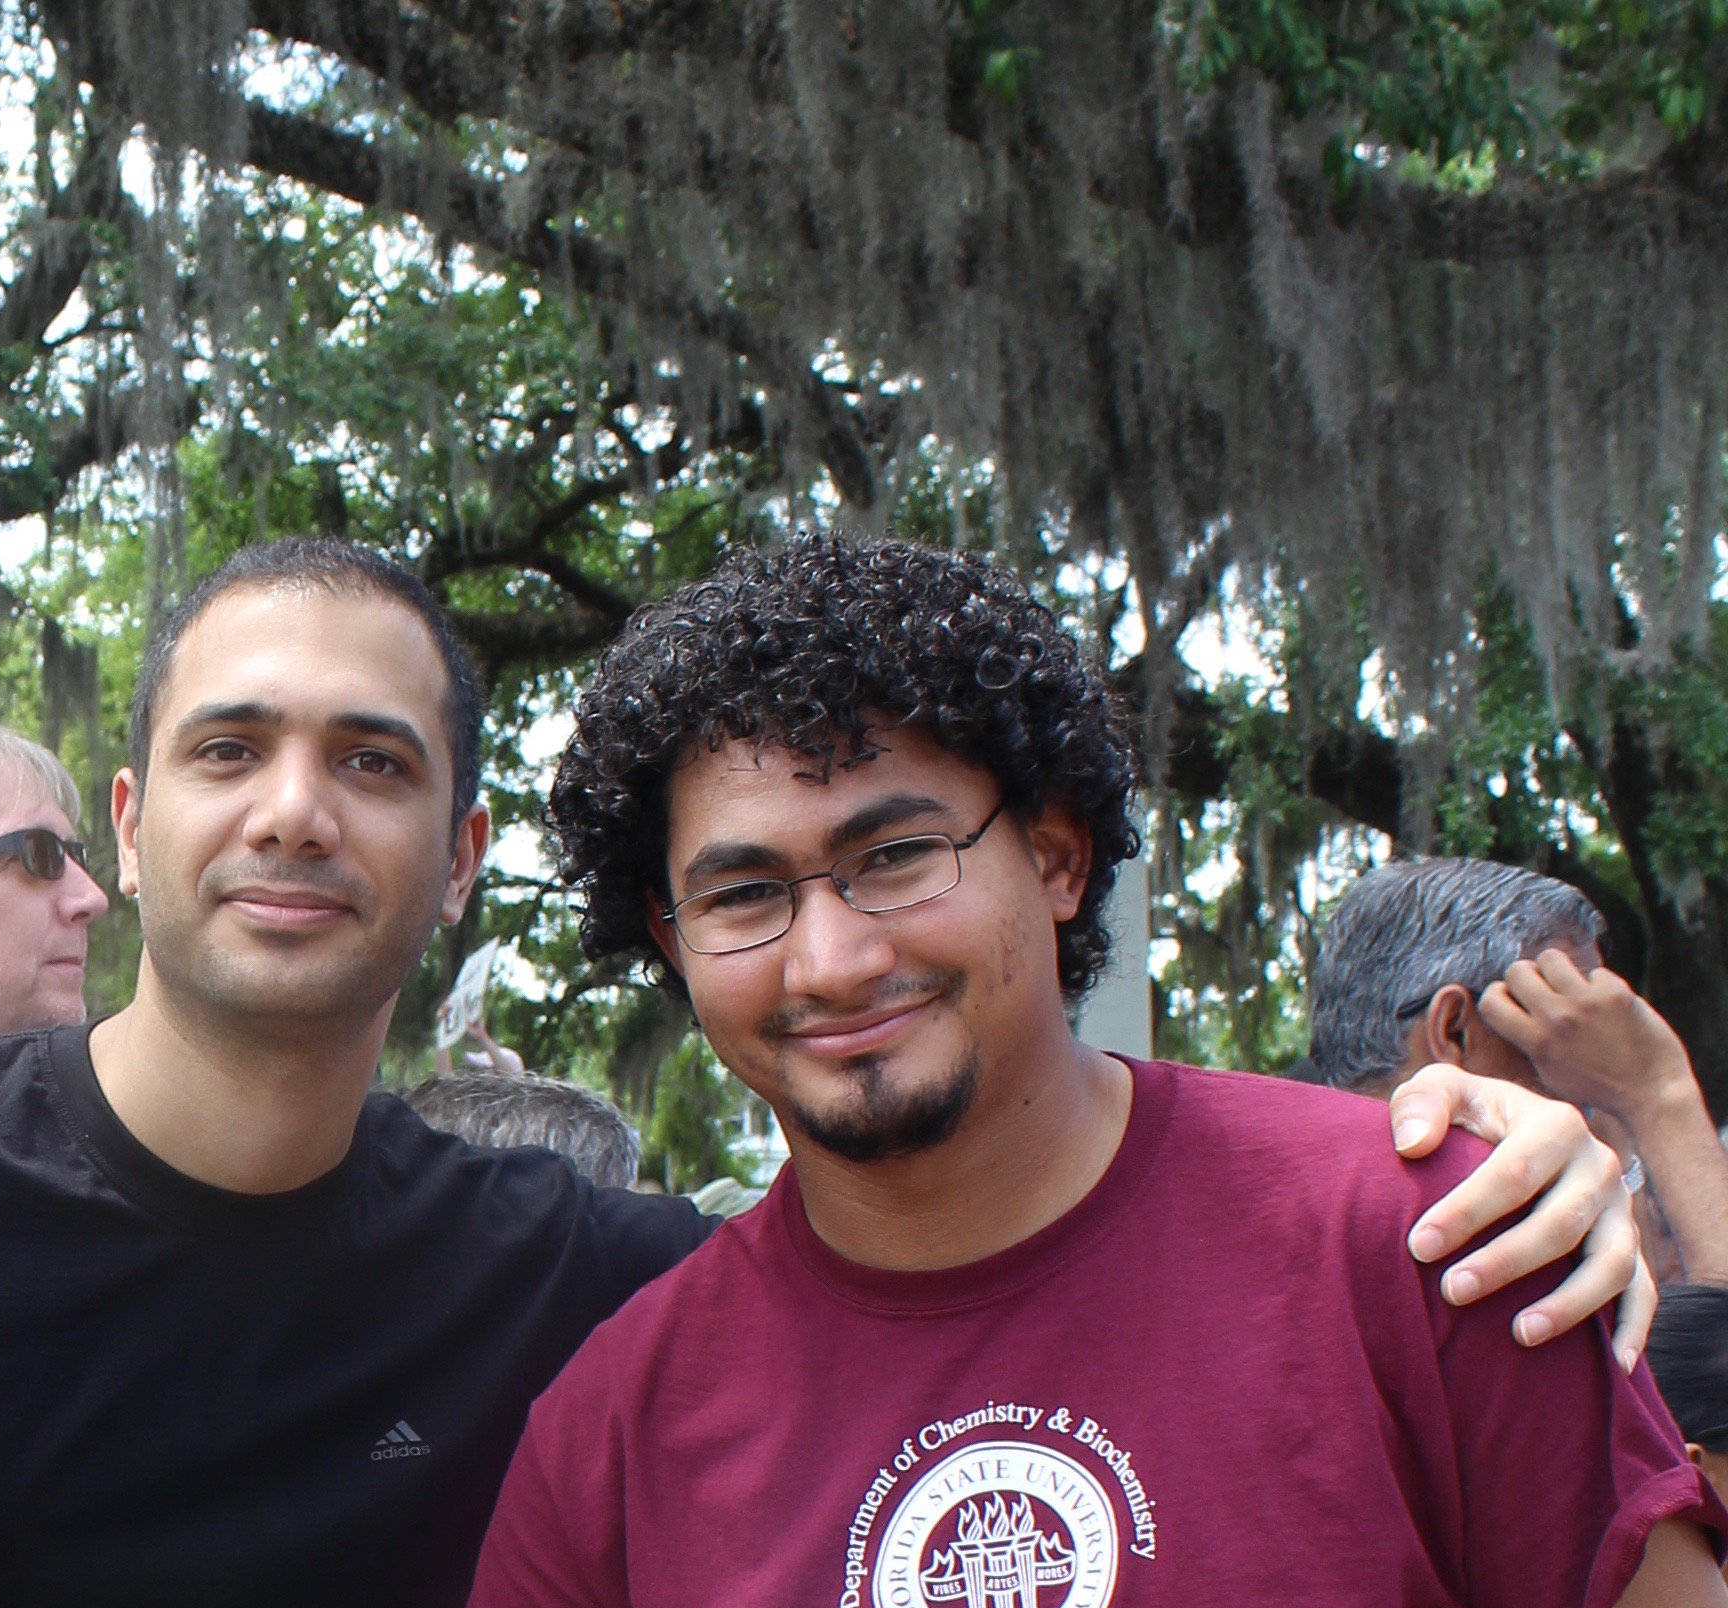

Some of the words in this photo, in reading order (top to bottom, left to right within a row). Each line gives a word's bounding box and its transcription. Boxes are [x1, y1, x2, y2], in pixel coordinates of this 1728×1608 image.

[371, 1444, 431, 1460] adidas
[893, 1438, 921, 1471] of
[918, 1400, 1045, 1450] Chemistry
[1046, 1407, 1073, 1433] &
[1073, 1416, 1157, 1560] Biochemistry
[929, 1459, 1011, 1507] STATE
[1036, 1565, 1069, 1580] MORES
[932, 1582, 962, 1596] VIRES
[986, 1576, 1019, 1590] ARTES
